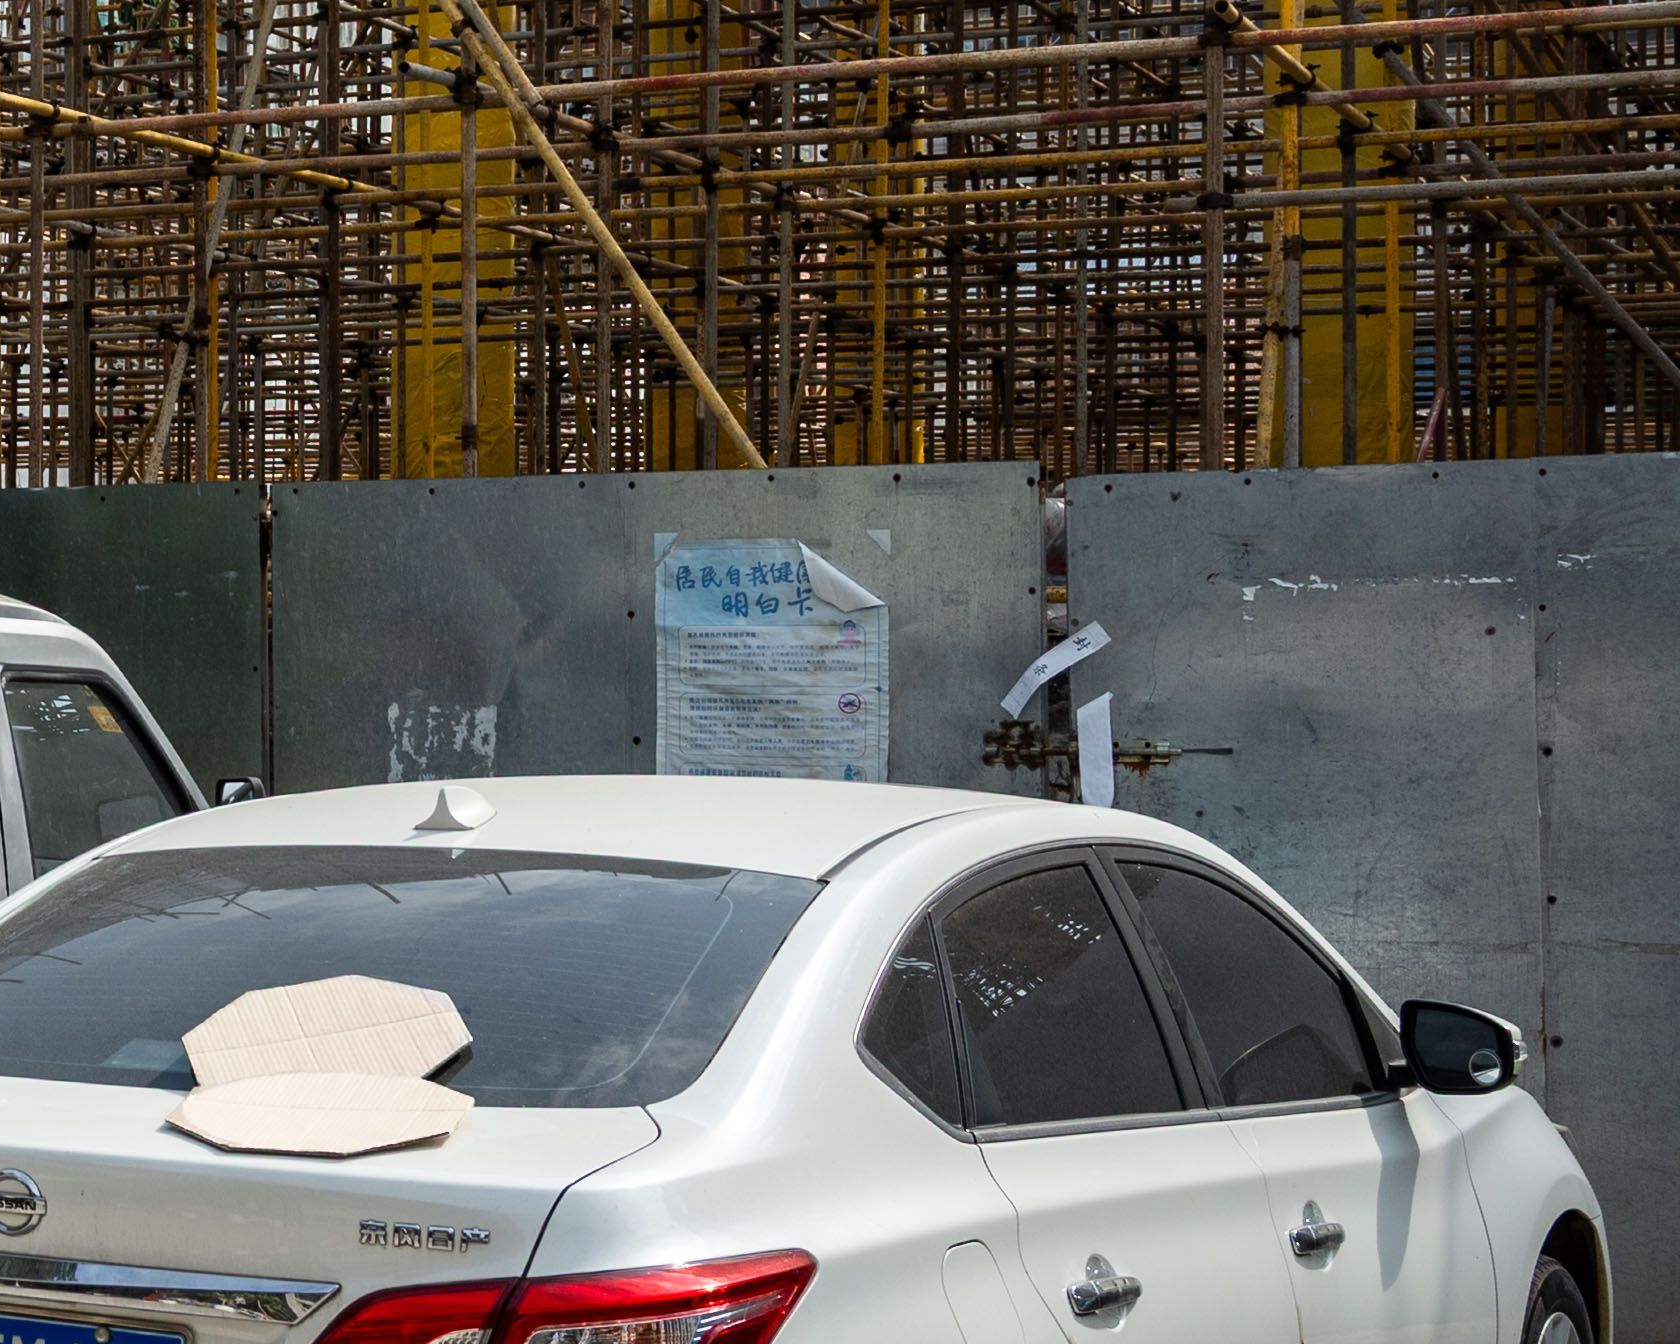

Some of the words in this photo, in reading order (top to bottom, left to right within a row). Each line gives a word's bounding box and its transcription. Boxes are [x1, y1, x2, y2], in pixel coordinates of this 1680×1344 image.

[722, 586, 814, 618] 明白卡
[359, 1218, 491, 1252] 东风日产
